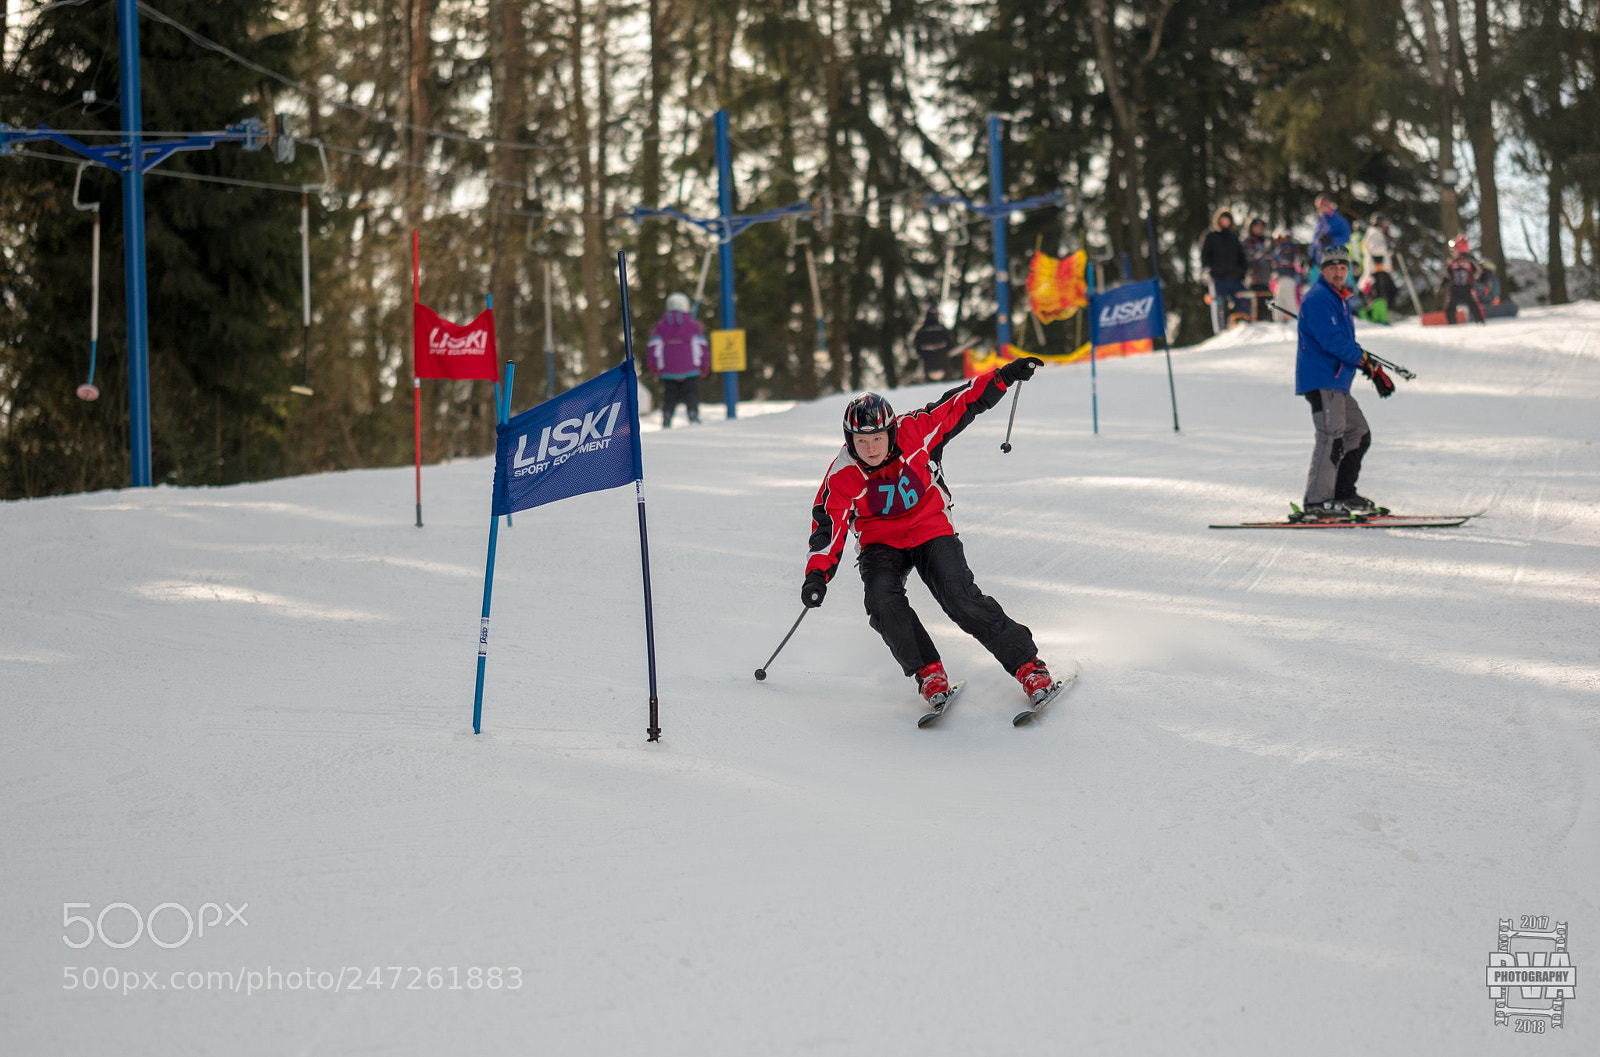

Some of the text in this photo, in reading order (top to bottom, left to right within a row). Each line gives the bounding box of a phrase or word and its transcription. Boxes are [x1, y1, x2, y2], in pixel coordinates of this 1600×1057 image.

[1099, 296, 1154, 322] LISKI
[429, 327, 488, 349] LISKI
[513, 402, 621, 469] LISKI
[514, 438, 612, 477] SPORT EQMENT
[878, 476, 919, 514] 76
